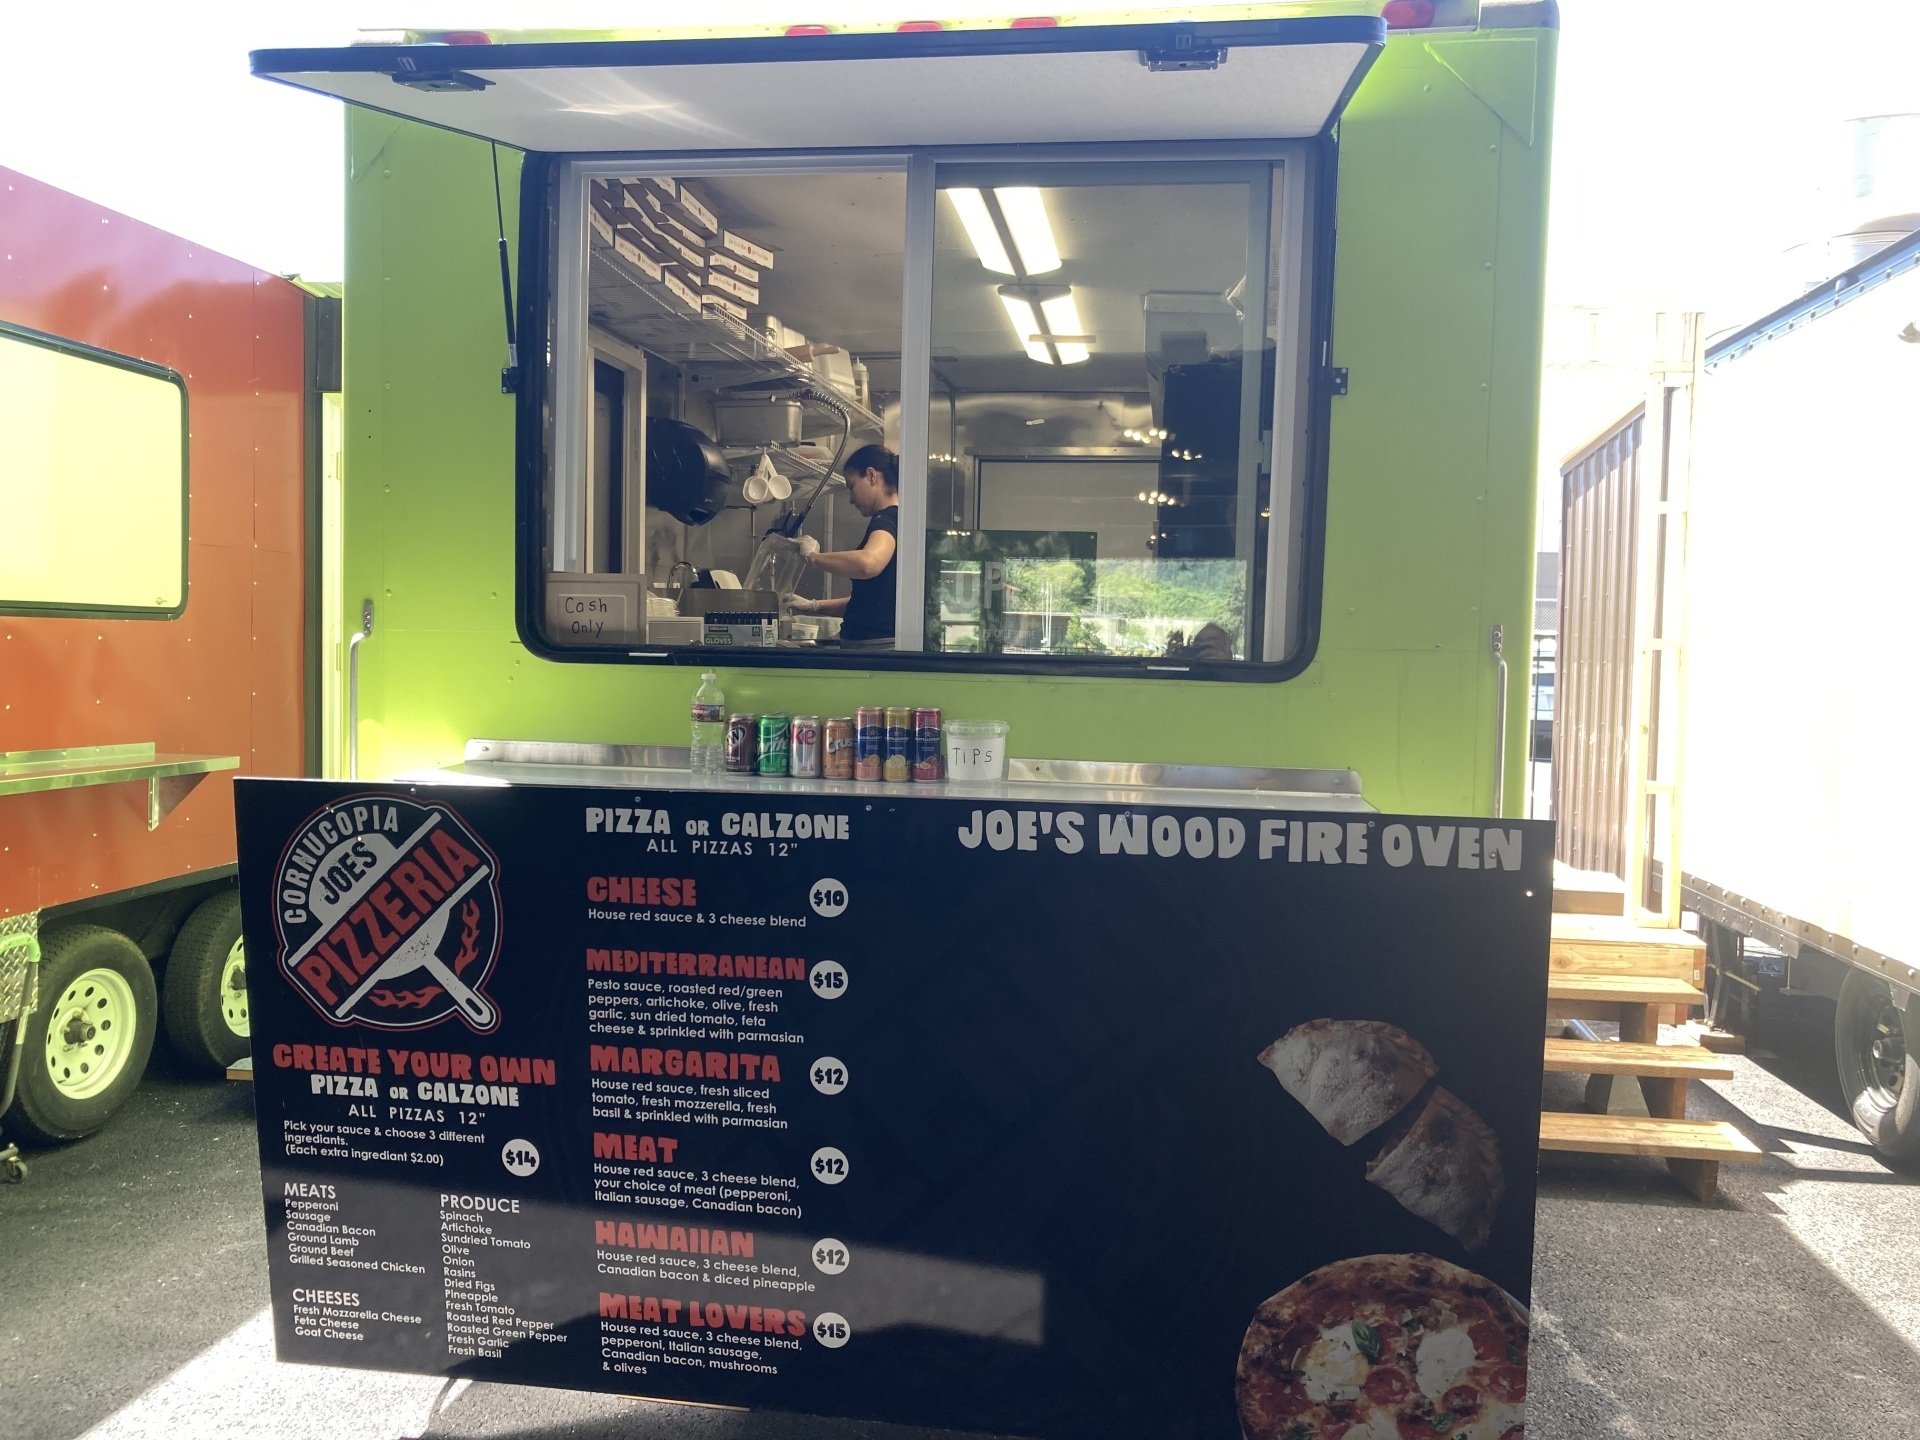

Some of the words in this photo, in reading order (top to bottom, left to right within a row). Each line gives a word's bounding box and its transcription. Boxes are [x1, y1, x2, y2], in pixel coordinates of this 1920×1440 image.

[565, 597, 608, 614] Cash
[571, 620, 604, 639] Only
[952, 747, 992, 766] TIPS
[585, 807, 671, 834] PIZZA
[685, 819, 709, 836] OR
[721, 812, 849, 839] CALZONE
[646, 838, 677, 853] ALL
[692, 840, 752, 855] PIZZAS
[957, 809, 1084, 854] JOE'S
[1098, 813, 1245, 859] WOOD
[1258, 819, 1370, 864] FIRE
[1381, 823, 1522, 870] OVEN
[282, 805, 398, 924] CORNUCOPIA
[318, 841, 377, 905] JOES
[586, 876, 696, 906] CHEESE
[813, 889, 844, 907] $10
[297, 828, 480, 1006] PIZZERIA
[588, 908, 626, 920] House
[629, 910, 650, 921] red
[654, 913, 693, 923] sauce
[696, 912, 705, 923] &
[708, 912, 716, 924] 3
[719, 913, 766, 926] cheese
[770, 915, 806, 927] blend
[586, 948, 805, 980] MEDITERRANEAN
[588, 978, 620, 990] Pesto
[623, 982, 665, 993] sauce,
[668, 983, 715, 995] roasted
[719, 985, 783, 999] red/green
[813, 971, 844, 989] $15
[588, 995, 642, 1007] peppers,
[646, 996, 708, 1010] artichoke,
[712, 999, 745, 1012] olive,
[748, 1000, 778, 1012] fresh
[588, 1008, 626, 1021] garlic,
[630, 1011, 651, 1020] sun
[654, 1010, 686, 1022] dried
[689, 1012, 738, 1026] tomato,
[741, 1014, 765, 1026] feta
[589, 1021, 634, 1034] cheese
[637, 1024, 646, 1035] &
[649, 1025, 705, 1038] sprinkled
[708, 1028, 733, 1039] with
[272, 1043, 381, 1074] CREATE
[387, 1049, 471, 1080] YOUR
[479, 1055, 555, 1085] OWN
[590, 1044, 780, 1082] MARGARITA
[813, 1067, 844, 1086] $12
[310, 1074, 378, 1098] PIZZA
[389, 1086, 408, 1100] OR
[417, 1081, 519, 1107] CALZONE
[591, 1077, 629, 1090] House
[632, 1081, 652, 1091] red
[656, 1084, 697, 1095] sauce,
[700, 1084, 729, 1096] fresh
[733, 1086, 769, 1099] sliced
[348, 1103, 376, 1118] ALL
[389, 1106, 444, 1122] PIZZAS
[591, 1092, 638, 1106] tomato,
[641, 1094, 670, 1107] fresh
[747, 1101, 776, 1114] fresh
[283, 1120, 307, 1131] Pick
[309, 1123, 334, 1133] your
[336, 1125, 371, 1135] sauce
[374, 1126, 381, 1136] &
[384, 1127, 426, 1139] choose
[429, 1129, 436, 1140] 3
[438, 1130, 485, 1143] different
[284, 1131, 348, 1145] ingrediants.
[285, 1143, 317, 1155] (Each
[320, 1147, 348, 1157] extra
[410, 1152, 443, 1166] $2.00)
[593, 1132, 677, 1163] MEAT
[505, 1148, 537, 1168] $14
[815, 1157, 845, 1176] $12
[593, 1162, 630, 1175] House
[633, 1166, 654, 1177] red
[657, 1169, 697, 1181] sauce,
[701, 1170, 708, 1181] 3
[711, 1171, 757, 1184] cheese
[760, 1174, 799, 1189] blend,
[284, 1182, 336, 1199] MEATS
[594, 1178, 621, 1189] your
[623, 1179, 666, 1192] choice
[669, 1182, 681, 1193] of
[684, 1185, 716, 1195] meat
[719, 1185, 791, 1202] (pepperoni,
[284, 1198, 338, 1211] Pepperoni
[440, 1193, 520, 1213] PRODUCE
[285, 1209, 331, 1223] Sausage
[439, 1209, 483, 1222] Spinach
[286, 1220, 339, 1233] Canadian
[342, 1224, 376, 1236] Bacon
[440, 1221, 492, 1234] Artichoke
[287, 1231, 327, 1243] Ground
[329, 1235, 359, 1246] Lamb
[441, 1232, 487, 1245] Sundried
[490, 1236, 531, 1249] Tomato
[595, 1220, 754, 1257] HAWAIIAN
[288, 1243, 327, 1255] Ground
[330, 1246, 354, 1256] Beef
[441, 1244, 469, 1255] Olive
[816, 1248, 846, 1266] $12
[289, 1254, 323, 1265] Grilled
[326, 1256, 378, 1270] Seasoned
[380, 1261, 425, 1273] Chicken
[442, 1255, 475, 1267] Onion
[443, 1266, 476, 1278] Rasins
[597, 1263, 656, 1277] Canadian
[659, 1268, 699, 1281] bacon
[702, 1272, 710, 1282] &
[714, 1273, 749, 1286] diced
[753, 1277, 815, 1293] pineapple
[444, 1277, 472, 1289] Dried
[475, 1280, 495, 1293] Figs
[292, 1288, 360, 1307] CHEESES
[445, 1289, 498, 1303] Pineapple
[293, 1304, 320, 1315] Fresh
[322, 1306, 378, 1320] Mozzarella
[381, 1311, 421, 1324] Cheese
[445, 1300, 472, 1311] Fresh
[474, 1302, 515, 1315] Tomato
[598, 1291, 682, 1323] MEAT
[689, 1299, 807, 1336] LOVERS
[294, 1315, 316, 1326] Feta
[319, 1317, 359, 1329] Cheese
[446, 1311, 489, 1324] Roasted
[492, 1315, 512, 1326] Red
[515, 1317, 554, 1331] Pepper
[816, 1320, 846, 1339] $15
[294, 1326, 321, 1337] Goat
[323, 1328, 364, 1341] Cheese
[447, 1322, 489, 1335] Roasted
[492, 1326, 526, 1338] Green
[528, 1329, 567, 1343] Pepper
[447, 1333, 474, 1345] Fresh
[477, 1336, 509, 1348] Garlic
[448, 1344, 475, 1356] Fresh
[478, 1347, 502, 1358] Basil
